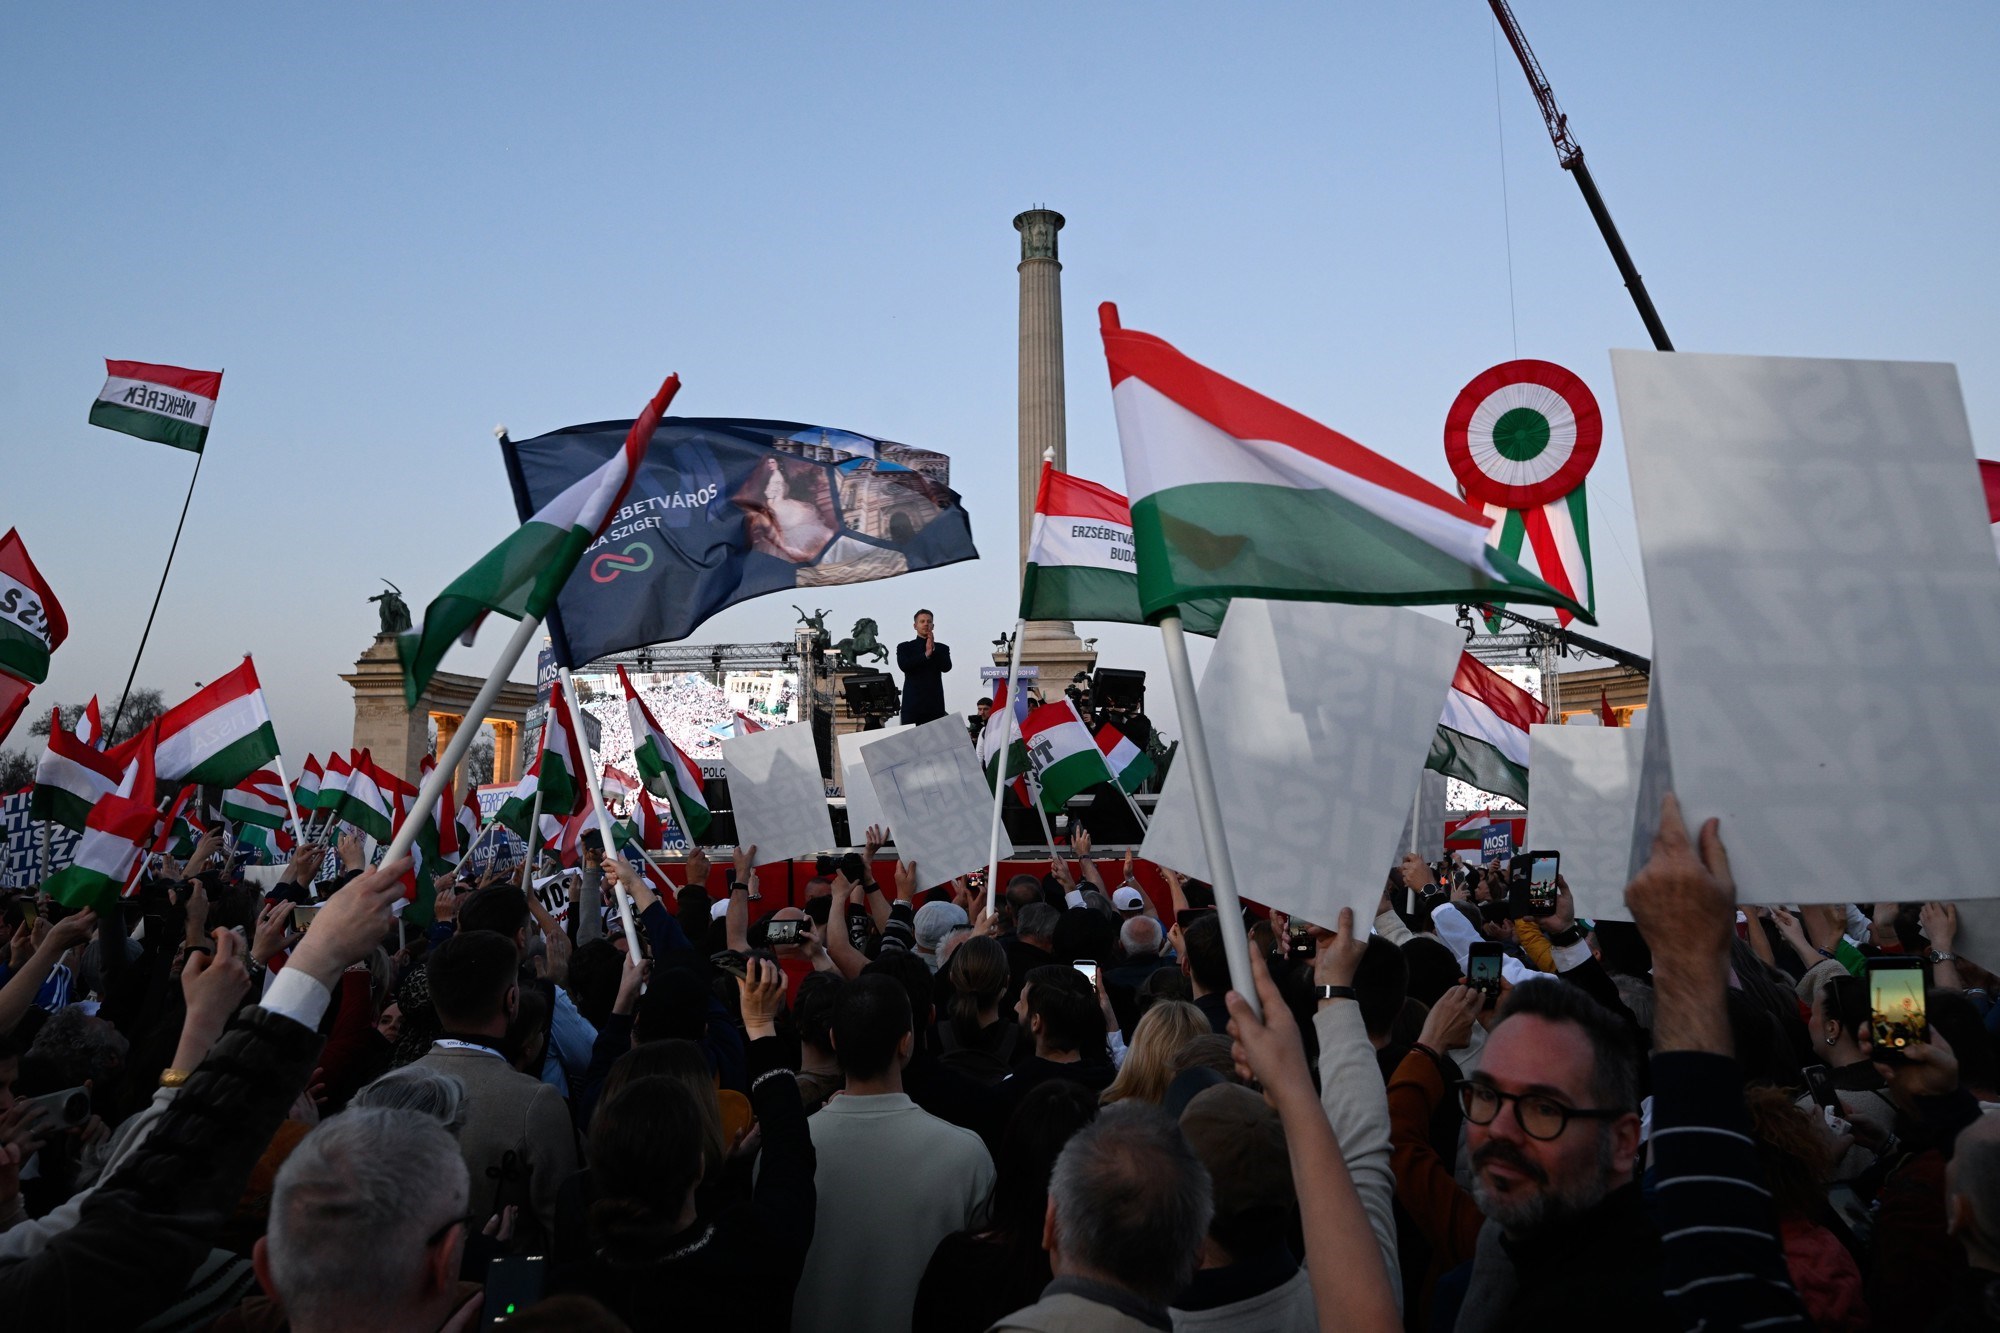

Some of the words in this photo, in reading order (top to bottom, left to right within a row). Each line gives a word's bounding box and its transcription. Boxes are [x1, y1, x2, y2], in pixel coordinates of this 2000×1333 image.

[611, 516, 661, 541] SZIGET
[1484, 834, 1509, 850] MOST
[474, 843, 500, 861] MOST
